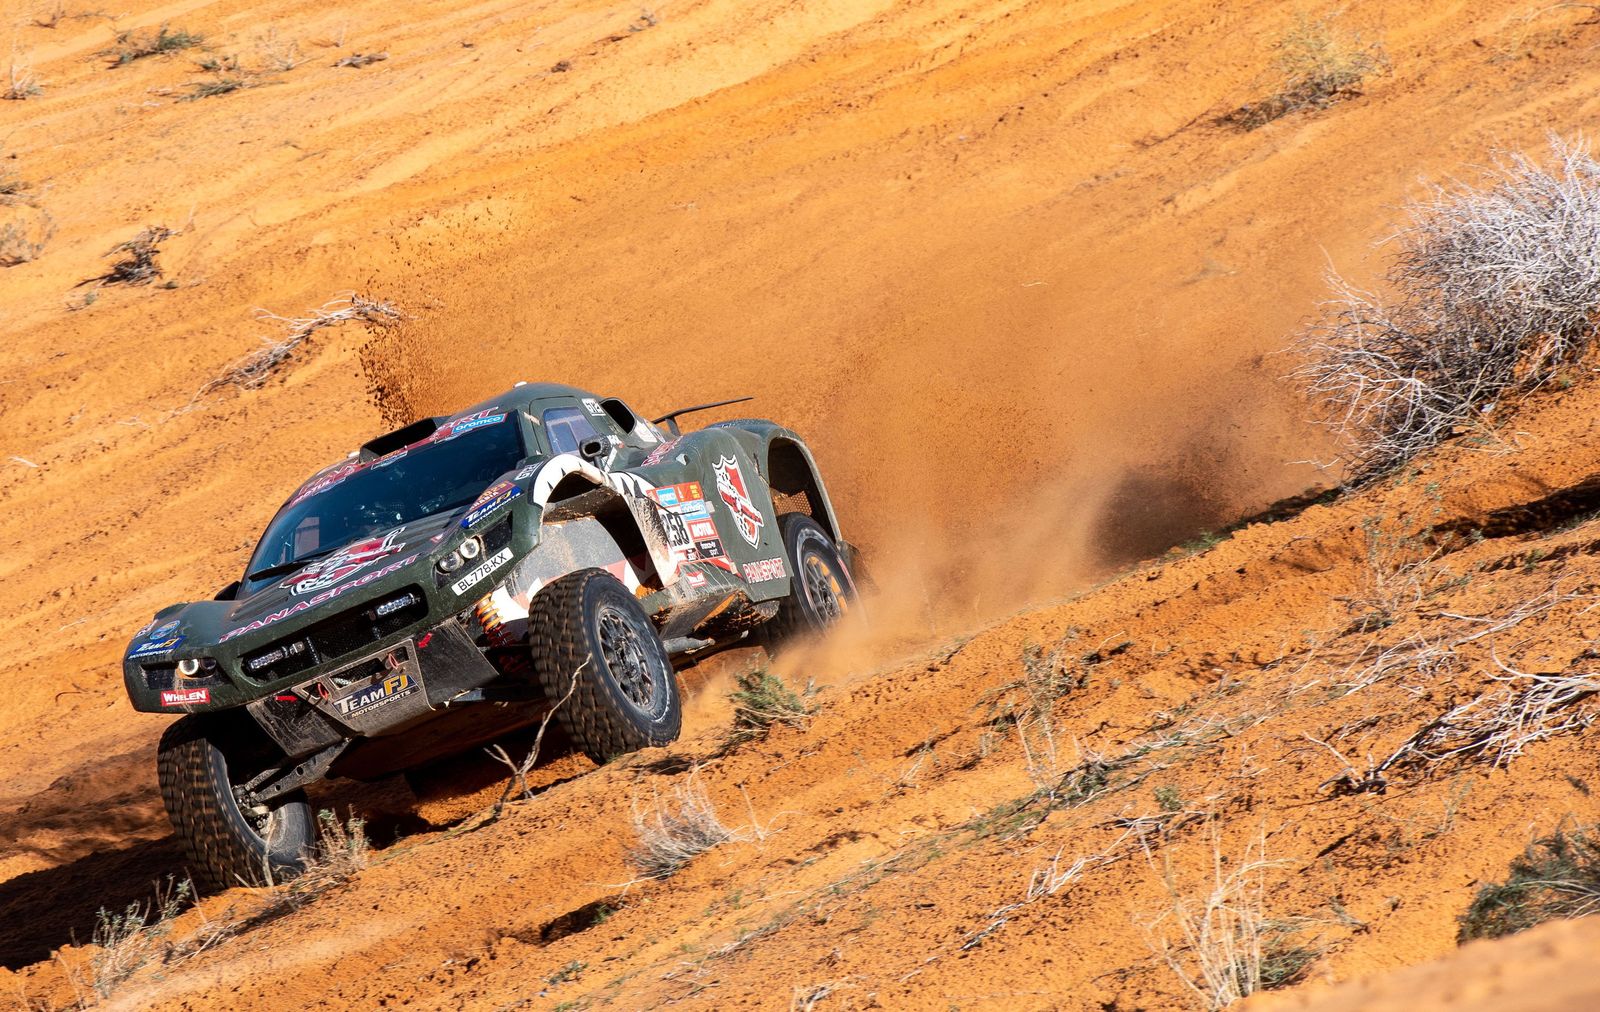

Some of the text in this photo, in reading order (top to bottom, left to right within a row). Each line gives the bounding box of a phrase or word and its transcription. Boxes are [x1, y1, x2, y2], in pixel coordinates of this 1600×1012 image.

[456, 416, 501, 431] aramco
[457, 552, 507, 591] BL-778-KX
[743, 558, 786, 583] PANASPORT
[219, 553, 419, 644] PANASPORT
[163, 690, 207, 702] WHELEN
[351, 690, 411, 718] MOTORSPORTS
